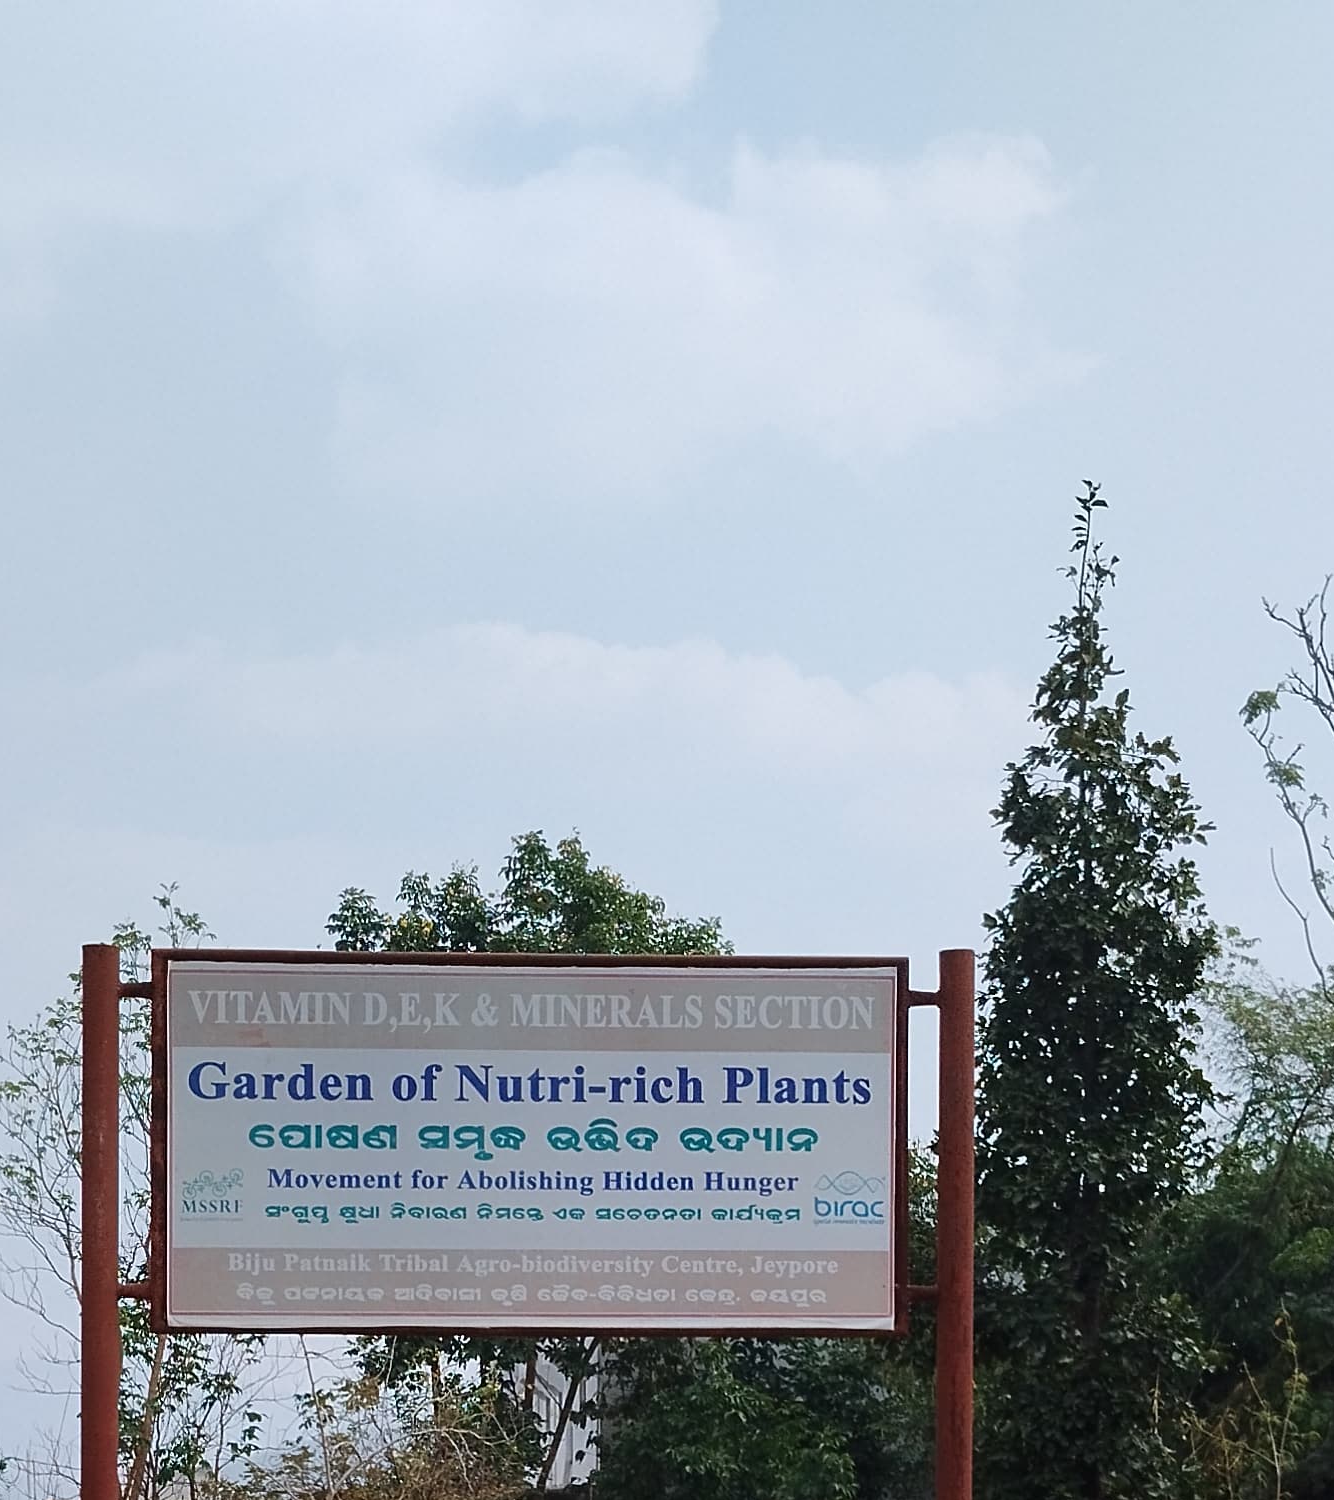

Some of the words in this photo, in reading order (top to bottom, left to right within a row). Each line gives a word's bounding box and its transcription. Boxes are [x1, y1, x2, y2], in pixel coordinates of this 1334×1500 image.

[187, 990, 352, 1025] VITAMIN
[362, 992, 461, 1034] D,E,K
[471, 992, 499, 1027] &
[509, 993, 703, 1029] MINERALS
[714, 994, 876, 1030] SECTION
[188, 1061, 374, 1101] Garden
[392, 1063, 443, 1102] of
[454, 1064, 705, 1104] Nutri-rich
[722, 1067, 871, 1105] Plants
[248, 1124, 397, 1150] ପୋଷଣ
[267, 1168, 402, 1189] Movement
[411, 1169, 449, 1190] for
[457, 1170, 594, 1196] Abolishing
[603, 1171, 694, 1191] Hidden
[705, 1171, 799, 1197] Hunger
[552, 1207, 586, 1220] ଏକ
[814, 1196, 884, 1218] birac
[228, 1252, 276, 1276] Biju
[283, 1253, 372, 1272] Patnaik
[378, 1253, 449, 1273] Tribal
[456, 1254, 655, 1278] Agro-biodiversity
[661, 1255, 744, 1277] Centre,
[750, 1255, 839, 1279] Jeypore
